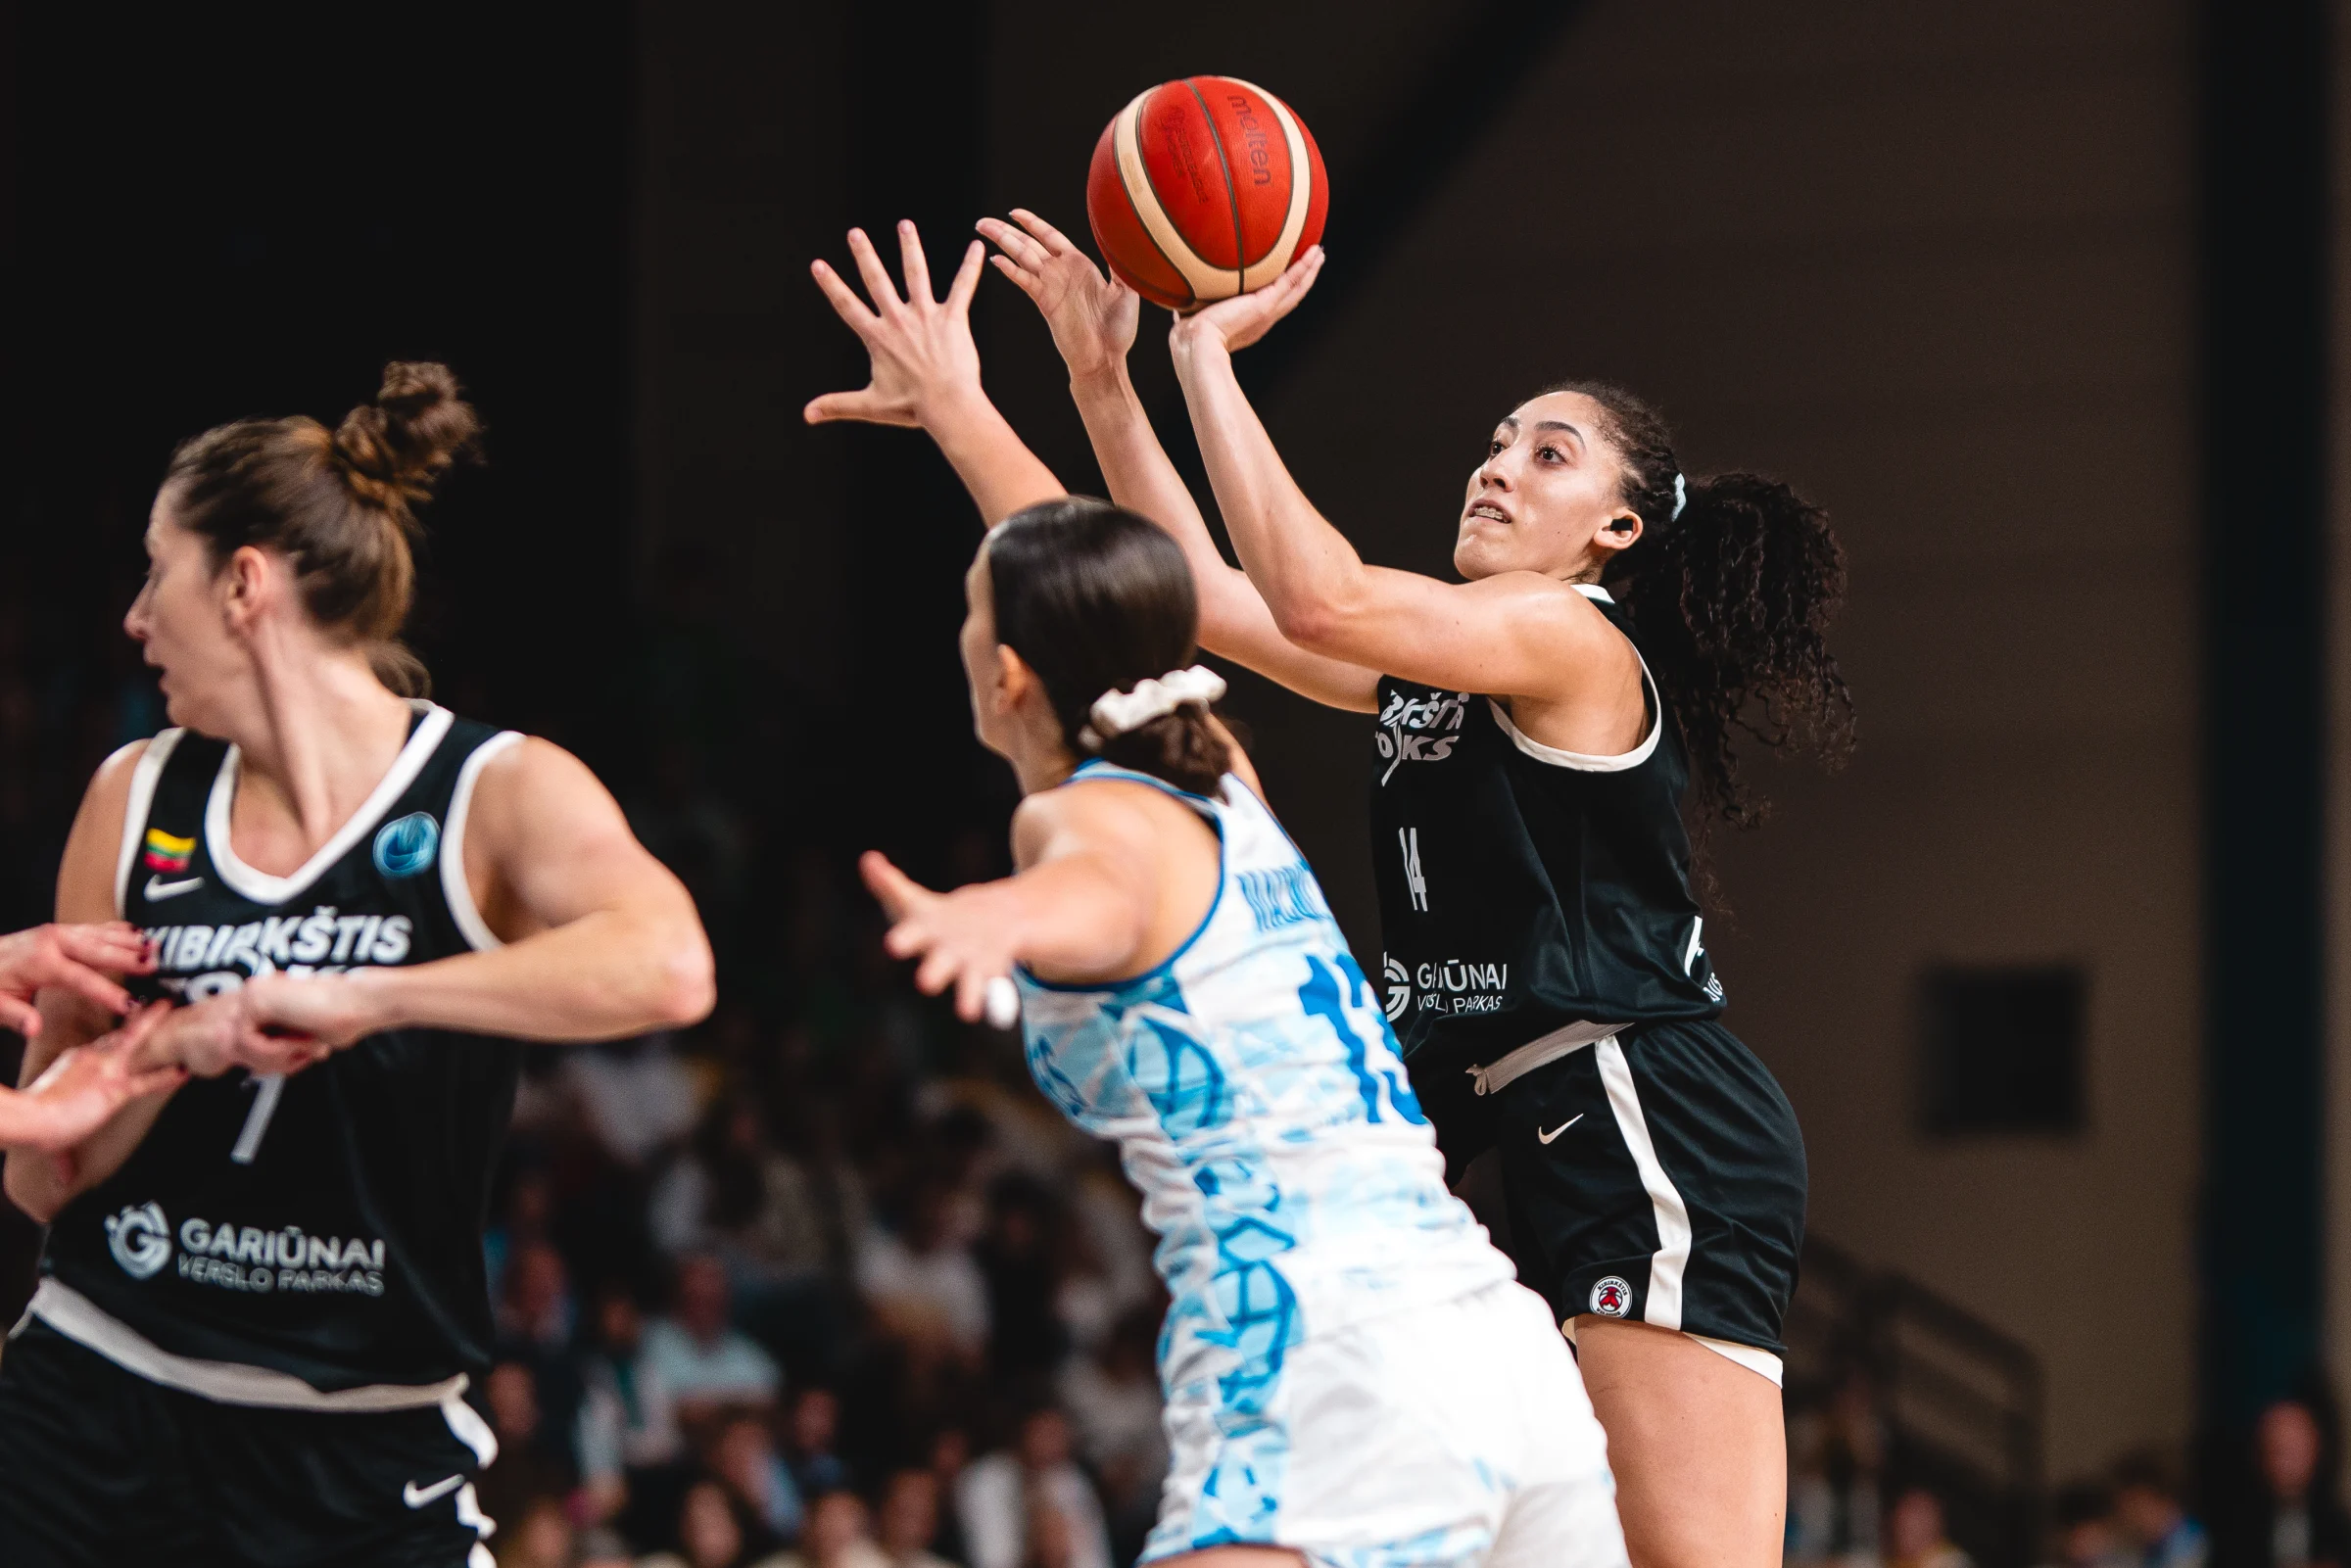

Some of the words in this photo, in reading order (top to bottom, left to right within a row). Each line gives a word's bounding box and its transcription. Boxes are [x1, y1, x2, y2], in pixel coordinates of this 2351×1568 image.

[1227, 95, 1271, 186] molten
[1375, 732, 1460, 761] OKS
[1399, 827, 1428, 912] 14
[179, 1217, 386, 1270] GARIŪNAI
[178, 1253, 274, 1294] VERSLO
[277, 1269, 386, 1298] PARKAS
